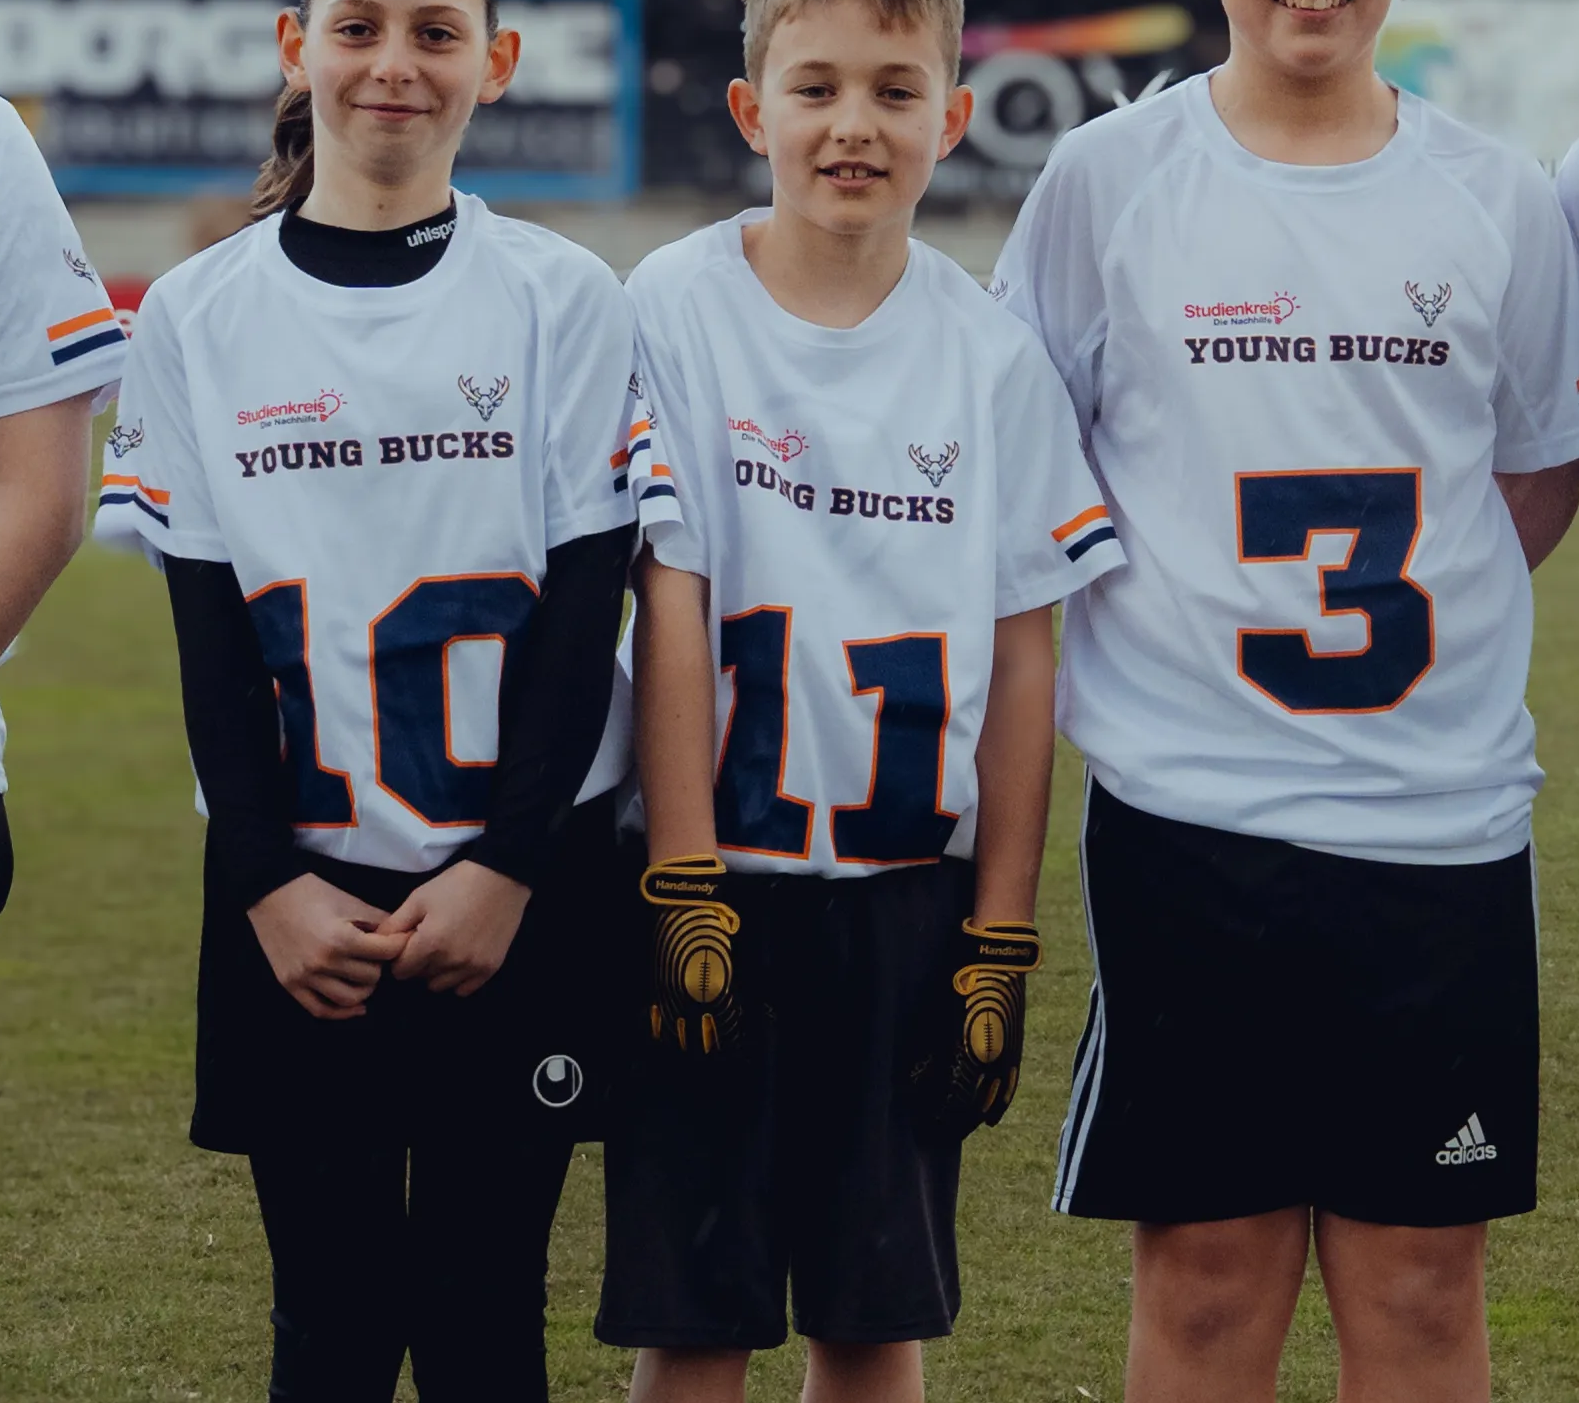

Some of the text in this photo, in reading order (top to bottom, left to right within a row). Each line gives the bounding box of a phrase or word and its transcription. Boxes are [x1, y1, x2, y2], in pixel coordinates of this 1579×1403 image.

[406, 218, 457, 247] uhlspo
[1184, 300, 1281, 319] Studienkreis
[1213, 318, 1228, 326] Die
[1184, 335, 1450, 366] YOUNG BUCKS
[237, 399, 326, 426] Studienkreis
[260, 419, 272, 429] Die
[235, 431, 514, 478] YOUNG BUCKS
[735, 458, 954, 525] OUNG BUCKS
[1234, 467, 1435, 715] 3
[245, 571, 541, 828] 10
[717, 605, 960, 866] 11
[1435, 1144, 1497, 1165] adidas
